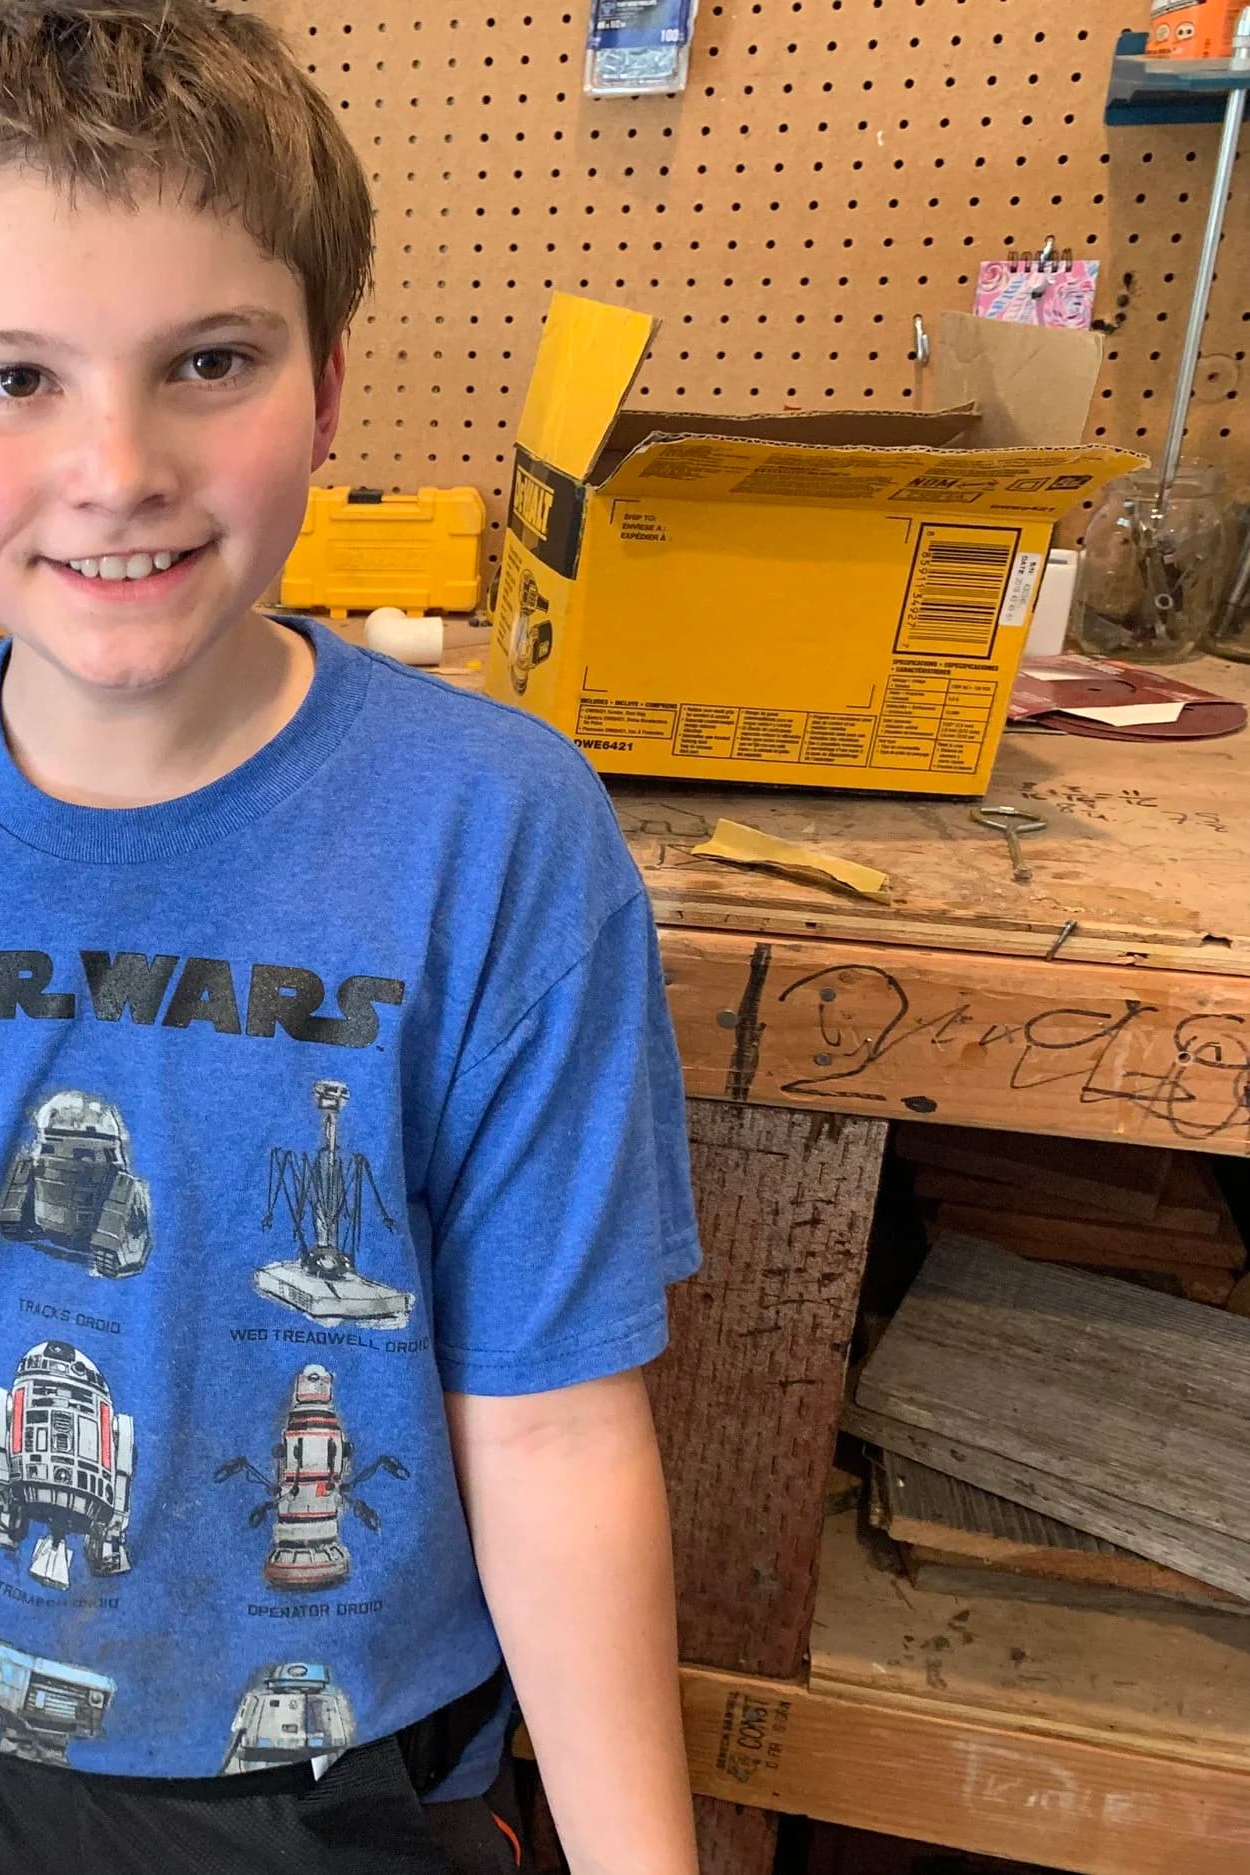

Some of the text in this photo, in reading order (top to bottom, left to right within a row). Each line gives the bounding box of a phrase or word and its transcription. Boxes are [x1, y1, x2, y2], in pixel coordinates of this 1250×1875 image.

[623, 513, 643, 521] SHIP
[574, 738, 634, 752] DWE6421
[79, 950, 405, 1048] WARS
[19, 1297, 121, 1335] TRACKS DROID
[230, 1328, 431, 1353] WED TREADWELL DROID
[335, 1600, 383, 1617] DROID
